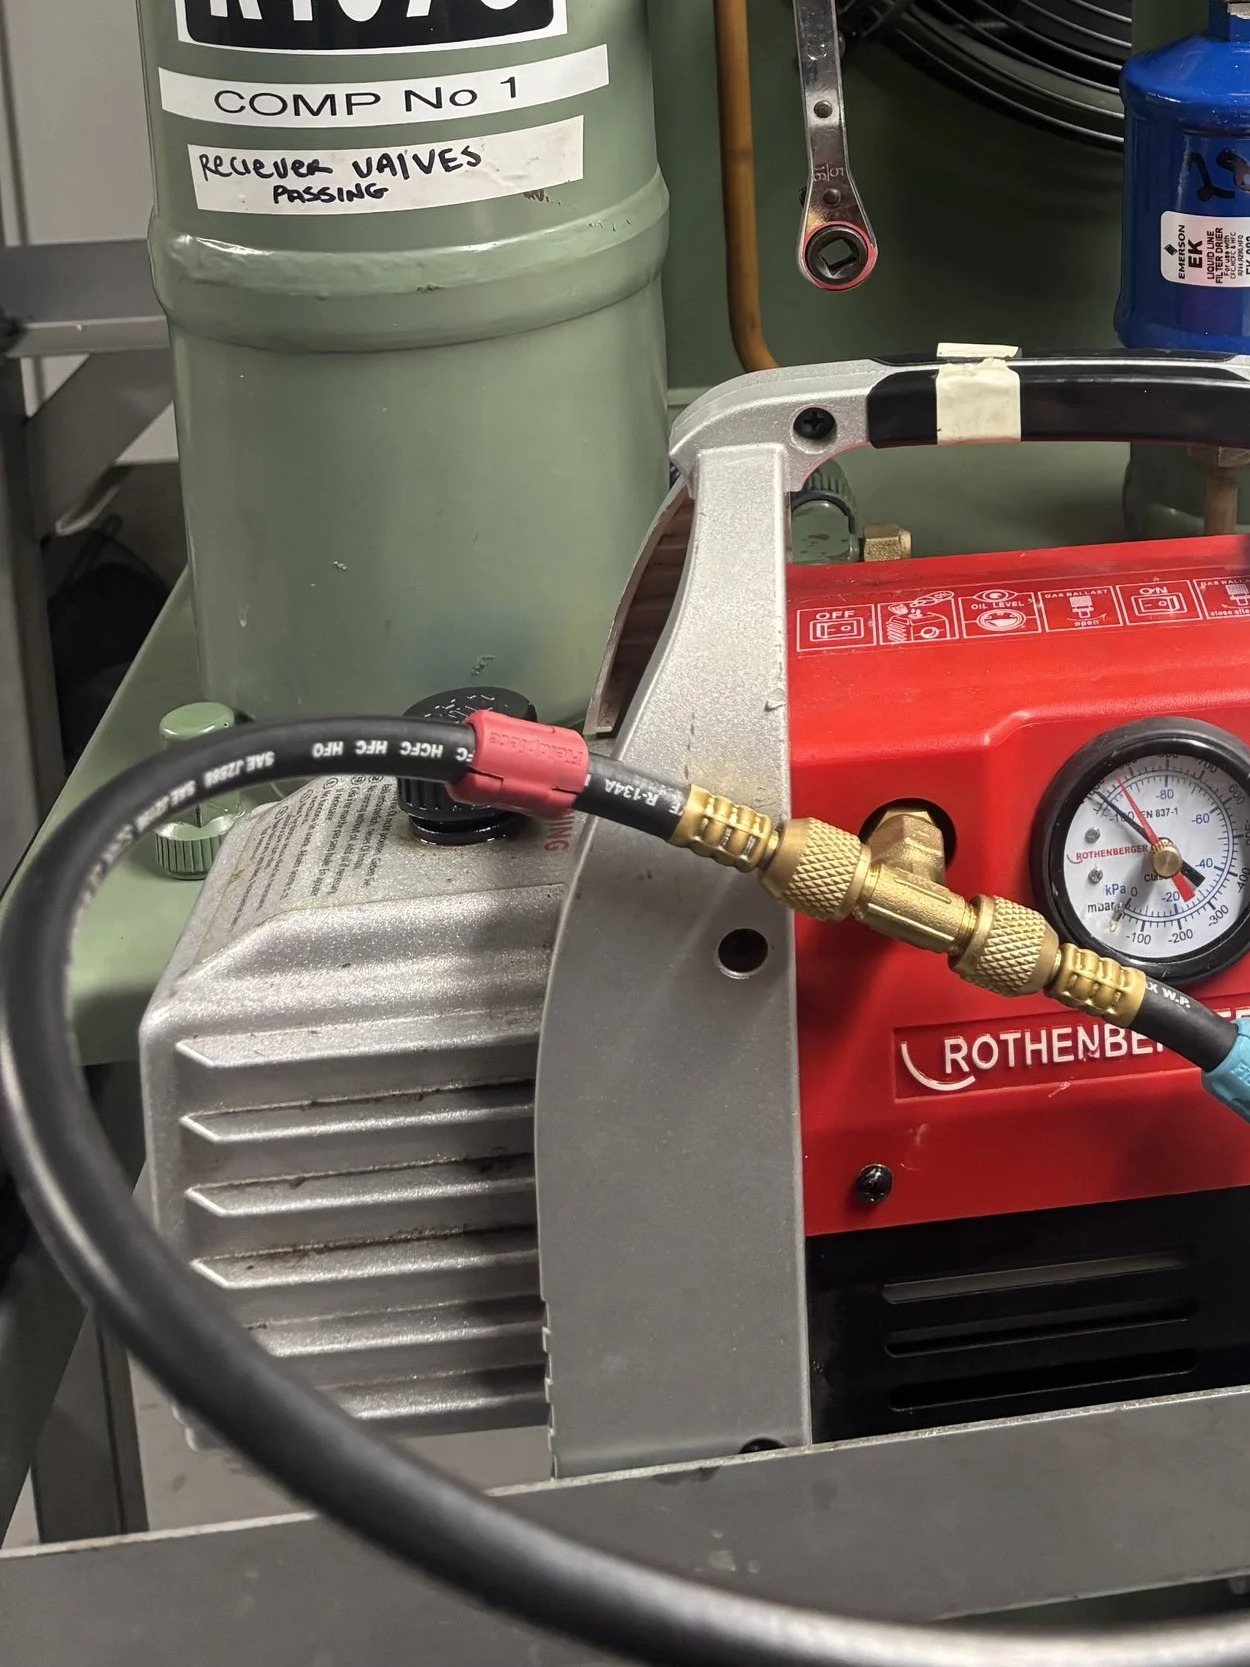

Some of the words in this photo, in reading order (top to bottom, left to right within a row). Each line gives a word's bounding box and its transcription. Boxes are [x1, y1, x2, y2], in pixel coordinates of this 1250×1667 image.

[214, 89, 381, 118] COMP
[405, 85, 478, 113] No
[500, 76, 518, 102] 1
[1215, 227, 1223, 253] DRIER
[1188, 239, 1203, 269] EK
[1215, 255, 1223, 284] FILTER
[1066, 588, 1108, 597] BALLAST
[1139, 586, 1168, 595] ON
[992, 600, 1024, 609] LEVEL
[816, 610, 855, 620] OFF
[1074, 619, 1100, 627] open
[312, 741, 344, 758] HFO
[354, 740, 388, 755] HFC
[400, 741, 443, 759] HCFC
[604, 778, 660, 807] R-134A
[1156, 789, 1174, 799] -80
[1155, 807, 1178, 817] 837-1
[1192, 813, 1210, 824] -60
[1076, 844, 1148, 861] ROTHENBERGER
[1195, 858, 1213, 868] -40
[1105, 884, 1126, 896] kPa
[1130, 886, 1138, 897] 0
[1161, 890, 1180, 902] -20
[1087, 900, 1115, 913] mbar
[1208, 904, 1229, 928] -300
[1125, 931, 1152, 945] -100
[1168, 928, 1193, 944] -200
[1163, 989, 1191, 1009] W.P.
